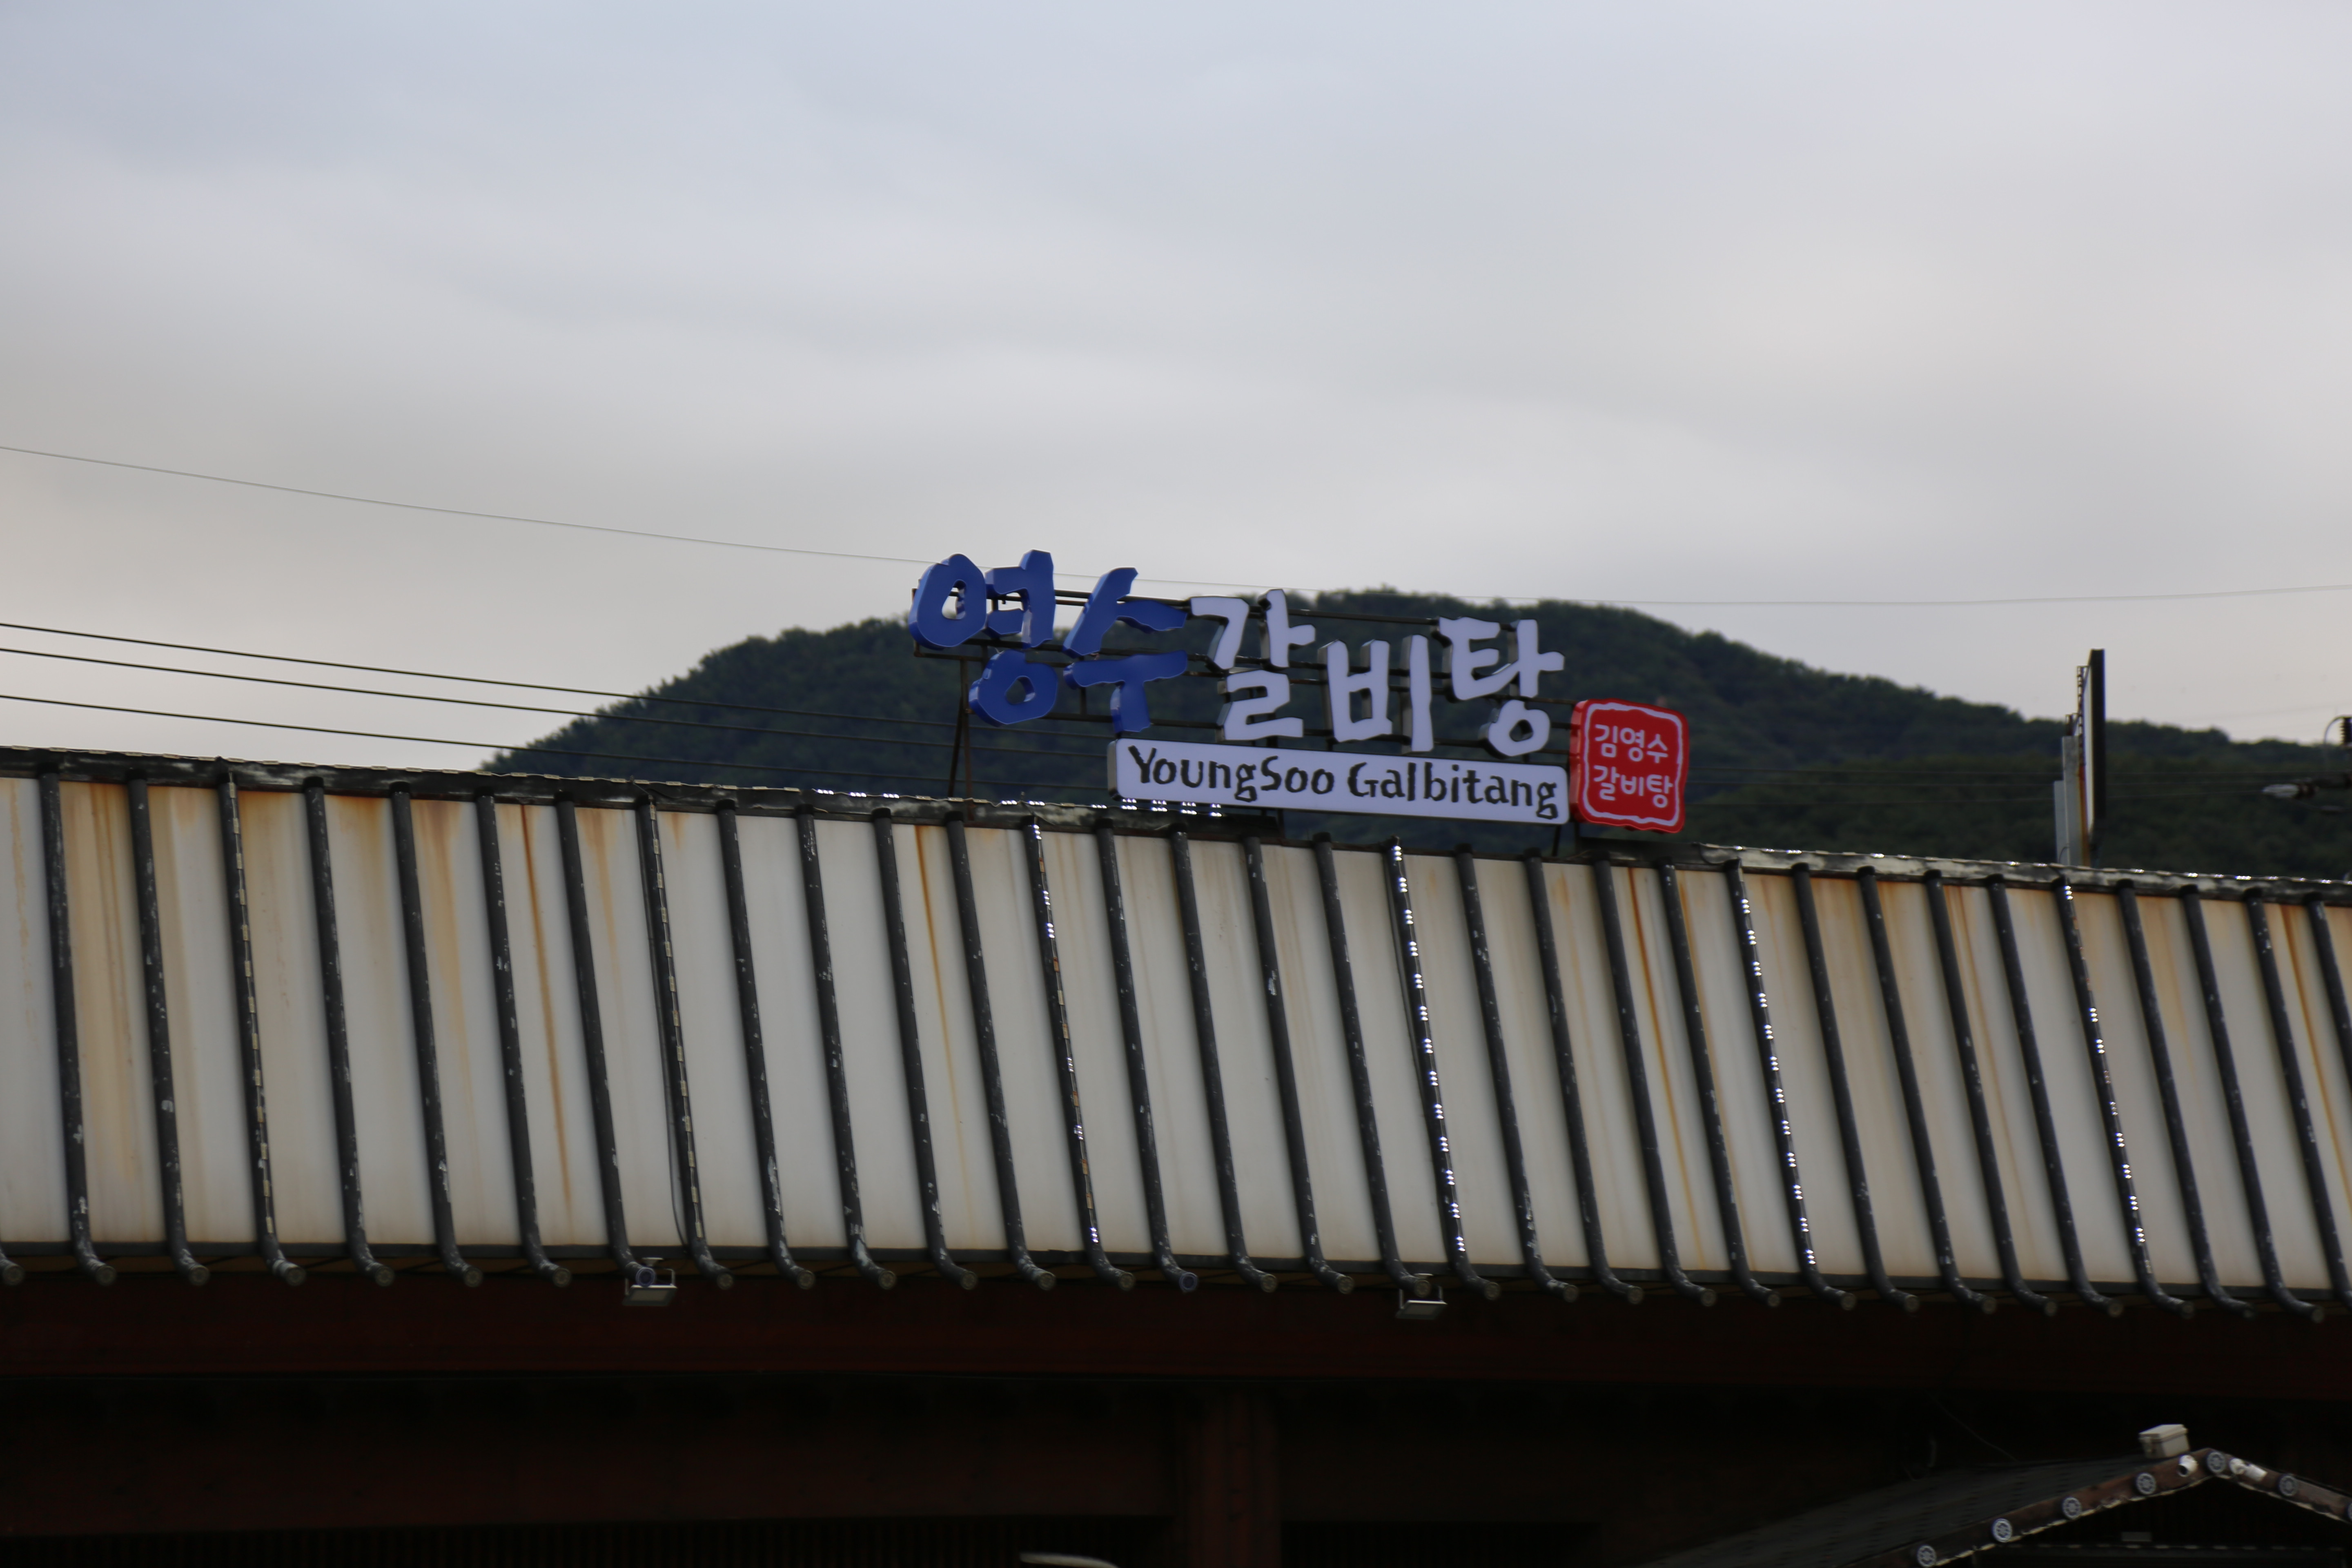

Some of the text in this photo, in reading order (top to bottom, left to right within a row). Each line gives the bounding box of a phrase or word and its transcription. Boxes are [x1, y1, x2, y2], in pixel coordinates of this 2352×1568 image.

[1595, 724, 1668, 763] 김영수
[1348, 762, 1558, 820] Galbitang
[1593, 765, 1674, 808] 갈비탕
